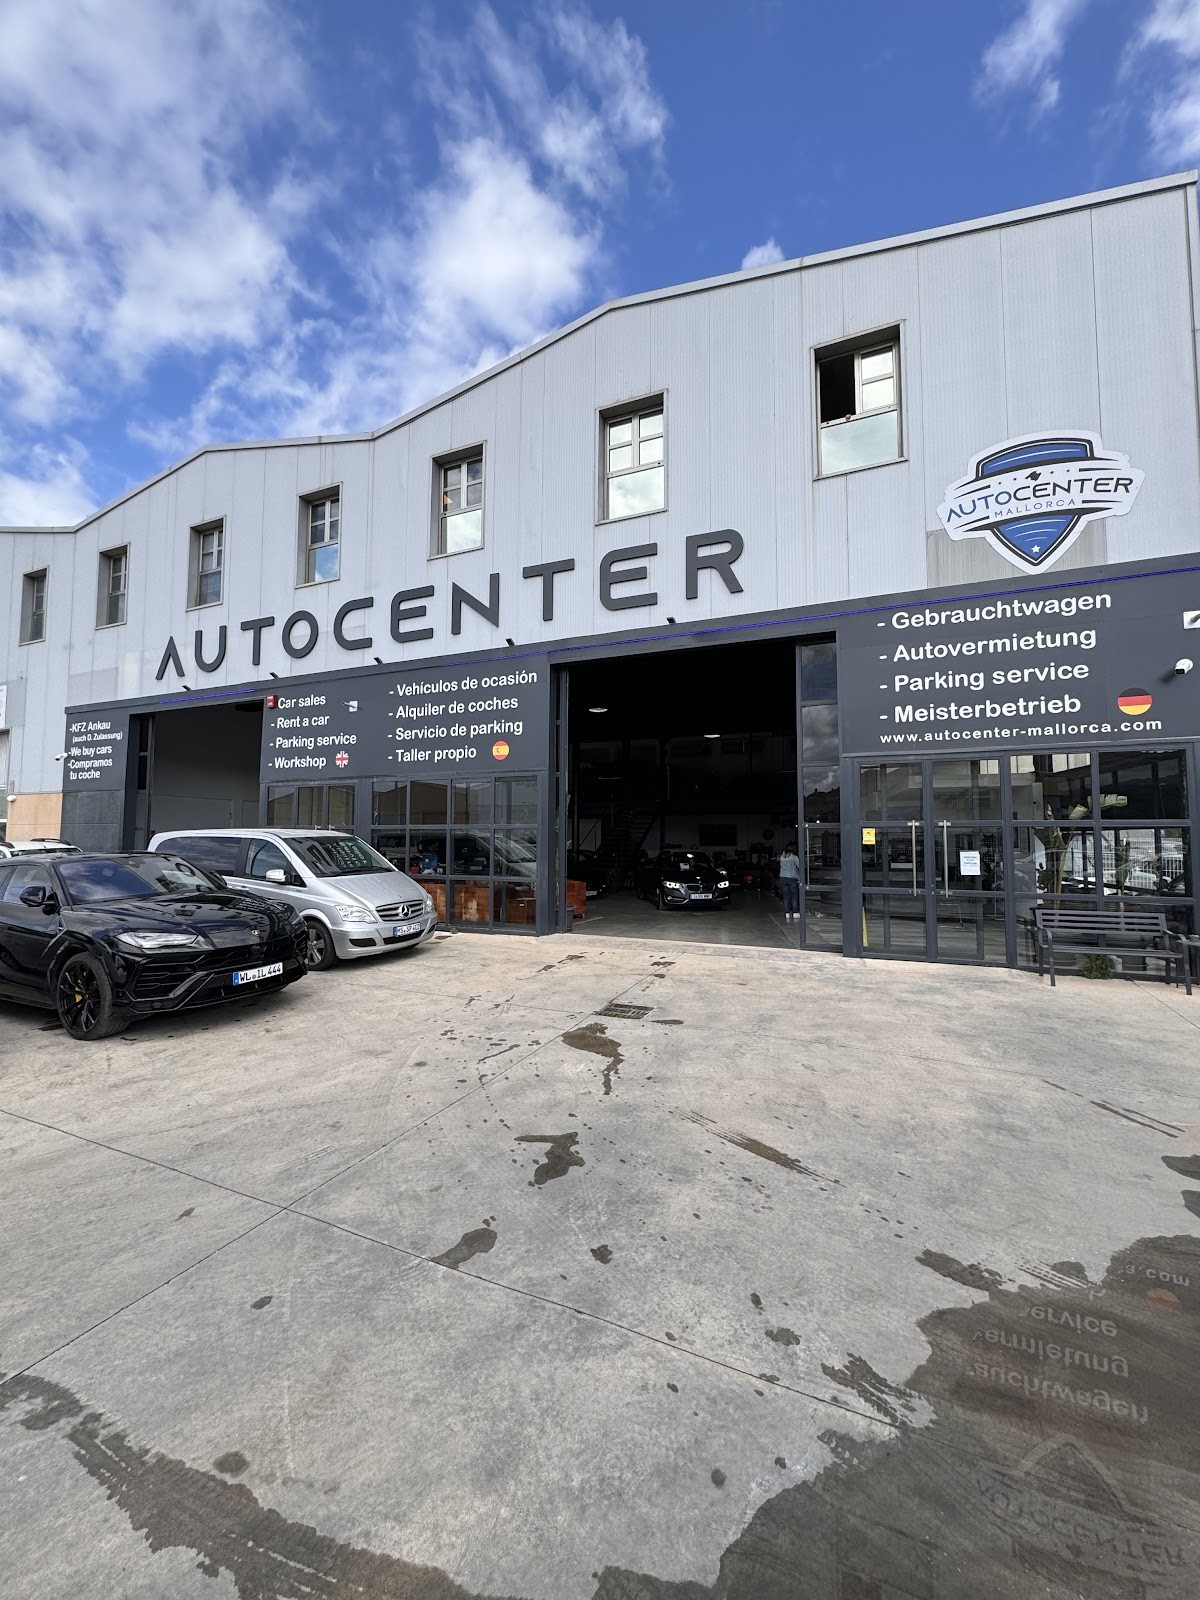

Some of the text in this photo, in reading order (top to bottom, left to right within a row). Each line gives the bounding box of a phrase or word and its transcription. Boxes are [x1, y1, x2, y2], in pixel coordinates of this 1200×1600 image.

[947, 478, 1134, 523] AUTOCENTER
[994, 498, 1076, 518] MALLORCA
[156, 528, 745, 680] AUTOCENTER
[892, 593, 1112, 629] Gebrauchtwagen
[894, 629, 1097, 662] Autovermietung
[397, 679, 458, 696] Vehículos
[462, 678, 477, 689] de
[482, 670, 538, 687] ocasión
[894, 670, 984, 692] Parking
[992, 662, 1089, 684] service
[278, 694, 326, 709] Car sales
[396, 701, 445, 719] Alquiler
[449, 700, 464, 712] de
[469, 697, 518, 710] coches
[894, 695, 1081, 723] Meisterbetrieb
[88, 721, 110, 731] Ankau
[277, 716, 301, 729] Rent
[303, 718, 309, 727] a
[311, 715, 329, 726] car
[396, 725, 447, 740] Servicio
[451, 723, 466, 736] de
[470, 719, 523, 738] parking
[880, 719, 1162, 743] www.autocenter-mallorca.com
[83, 746, 95, 757] buy
[96, 746, 112, 754] cars
[276, 736, 314, 750] Parking
[317, 733, 357, 746] service
[274, 756, 326, 769] Workshop
[396, 747, 431, 762] Taller
[435, 745, 476, 762] propio
[70, 769, 101, 780] tu coche
[240, 972, 251, 982] WL
[268, 965, 281, 975] 444
